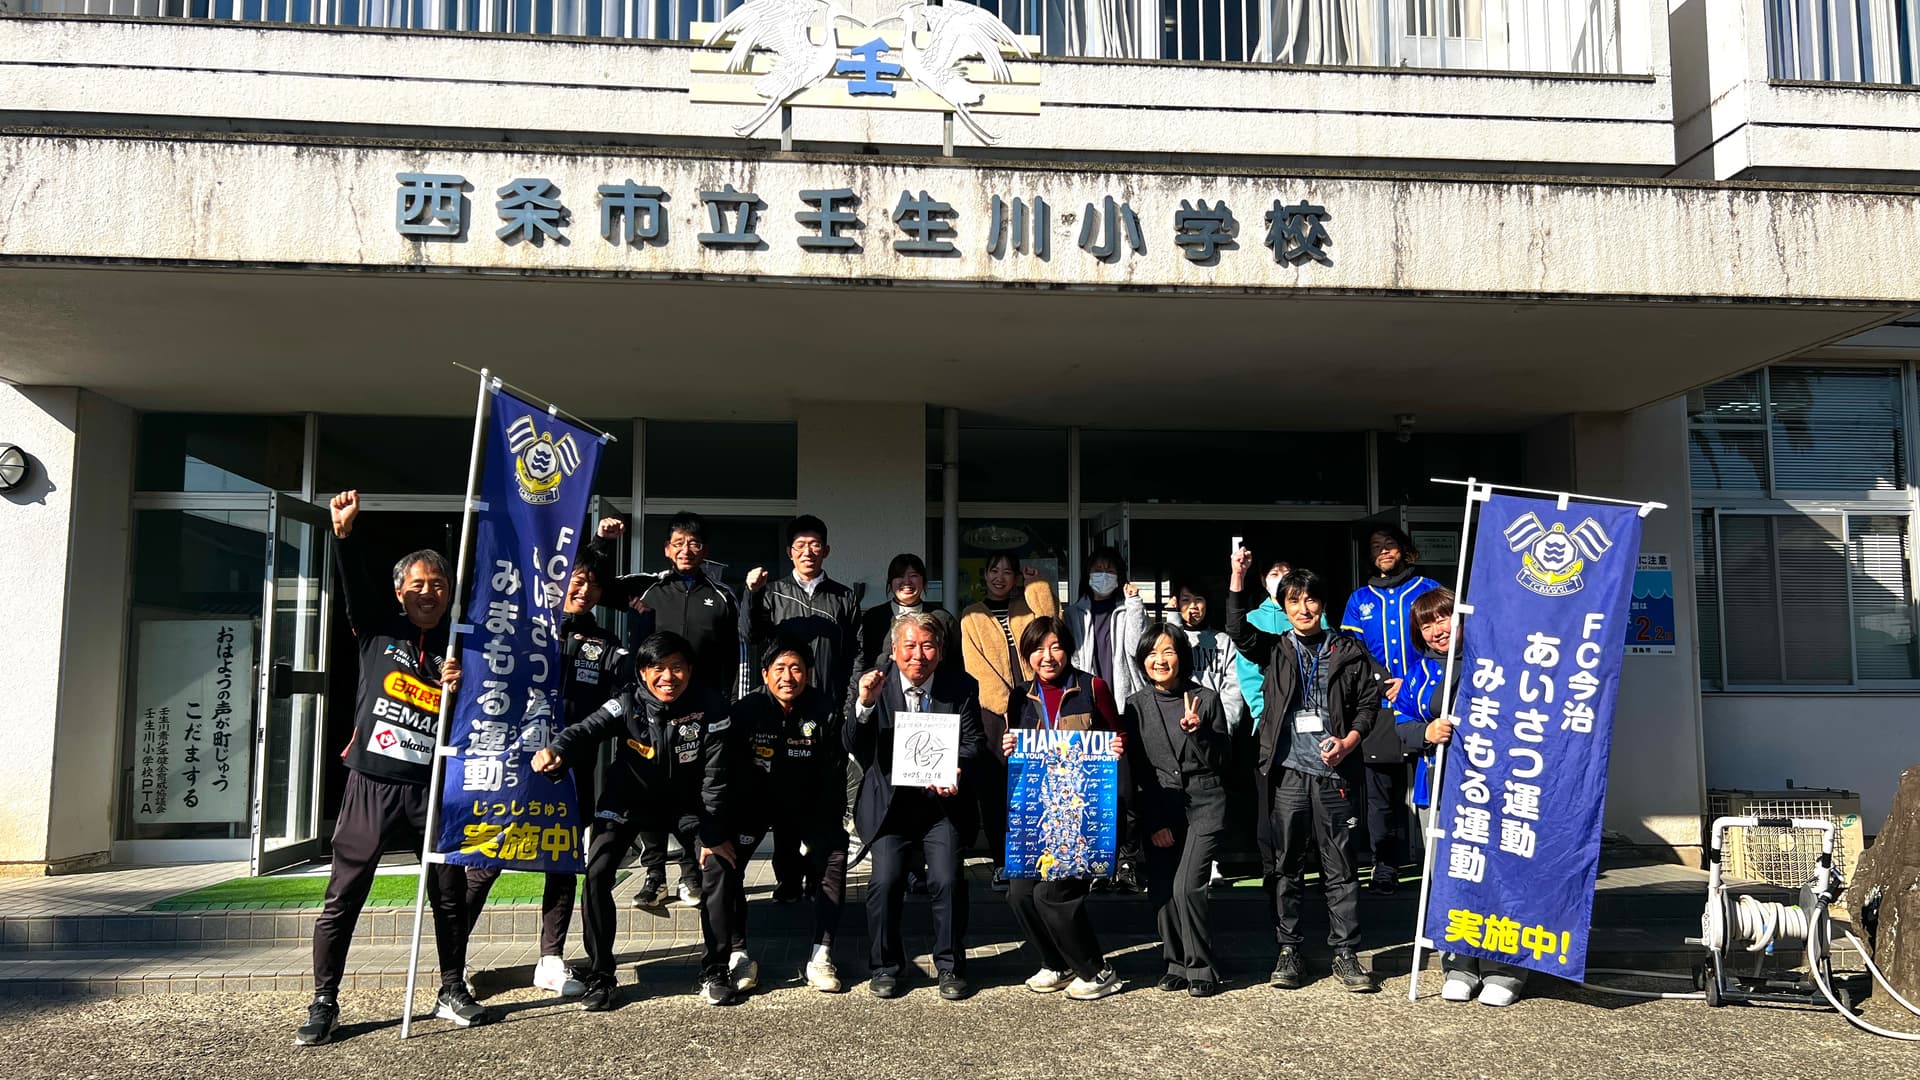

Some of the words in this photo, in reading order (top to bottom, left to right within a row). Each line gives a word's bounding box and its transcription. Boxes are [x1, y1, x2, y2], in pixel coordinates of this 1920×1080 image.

[396, 172, 1327, 262] 西条市立壬生川小学校
[212, 626, 234, 792] おはようの声が町じゅう
[463, 560, 522, 791] みまもる運動
[1561, 613, 1606, 733] FC今治
[140, 707, 156, 814] 壬生川小学校PTA
[181, 702, 202, 808] こだまする
[1010, 729, 1074, 753] THANK
[1447, 658, 1506, 884] みまもる運動
[1499, 632, 1561, 859] あいさつ運動
[460, 822, 579, 861] 実施中!
[472, 800, 567, 817] じっしちゅう
[1445, 909, 1571, 965] 実施中!
